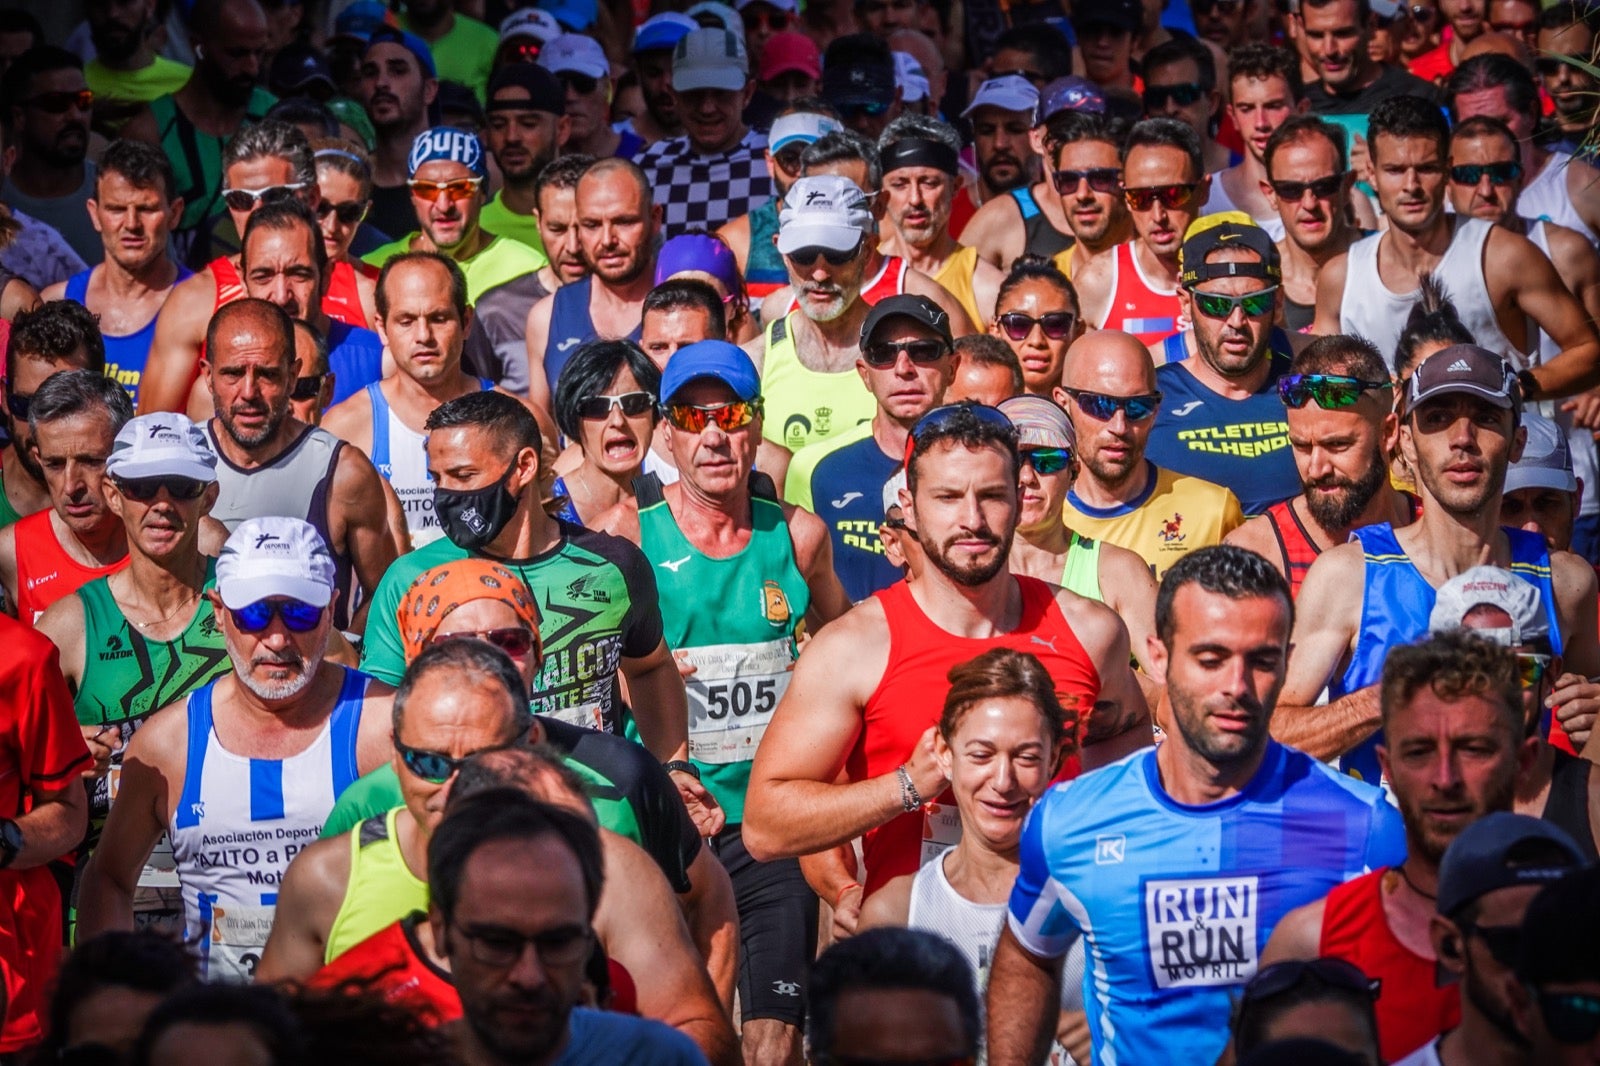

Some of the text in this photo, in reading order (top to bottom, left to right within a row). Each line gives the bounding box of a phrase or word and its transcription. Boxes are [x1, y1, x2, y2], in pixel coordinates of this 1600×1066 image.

[99, 650, 133, 661] VIATOR
[707, 679, 776, 719] 505
[202, 830, 273, 847] Asociación
[266, 849, 279, 863] a
[1156, 886, 1248, 922] RUN
[1193, 915, 1206, 931] &
[1161, 925, 1245, 967] RUN
[1168, 965, 1244, 981] MOTRIL
